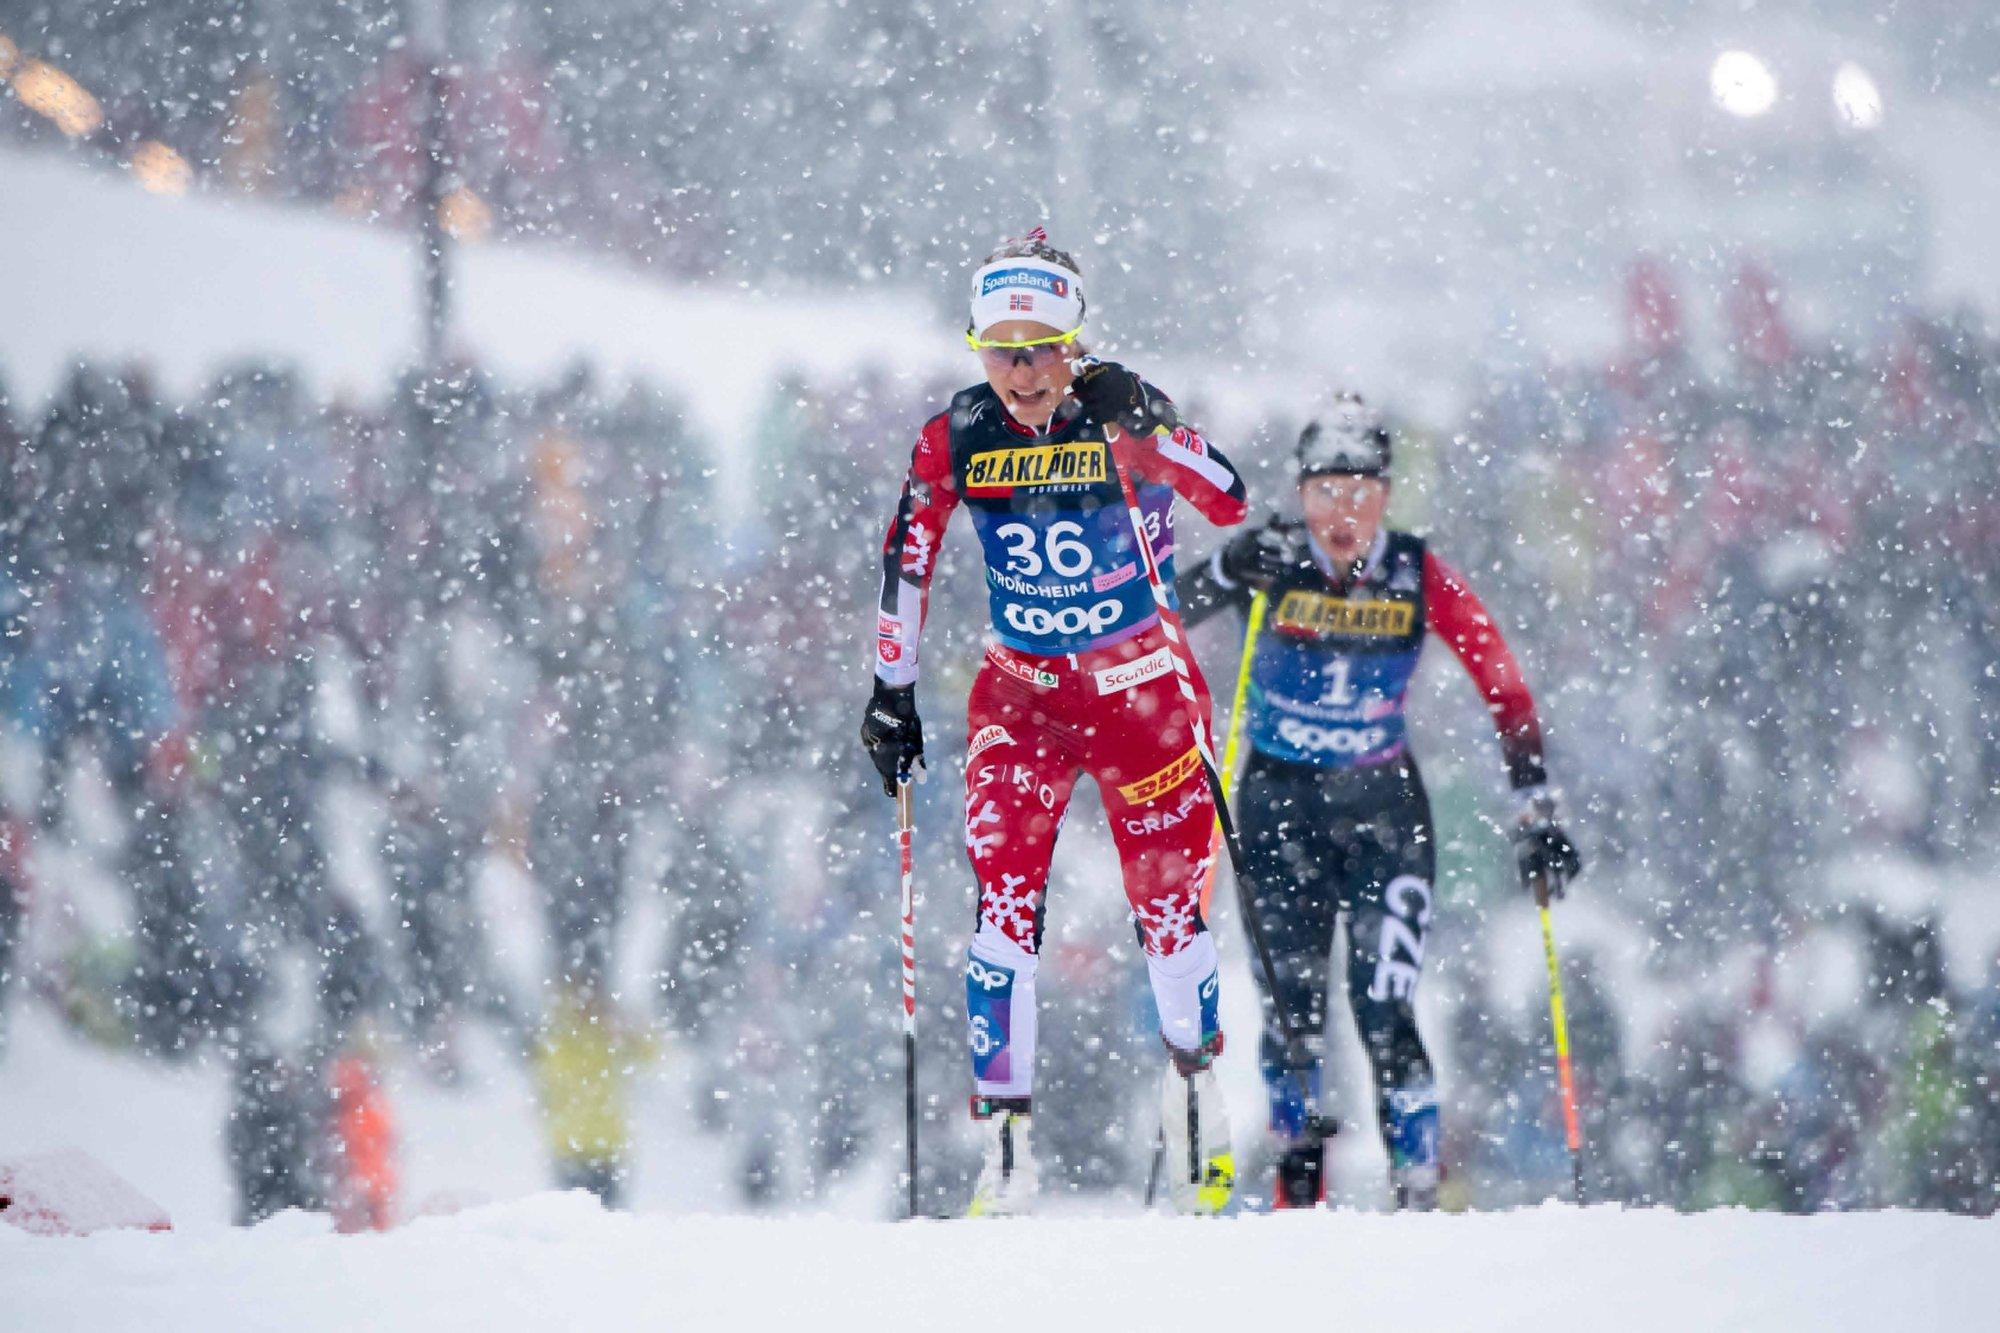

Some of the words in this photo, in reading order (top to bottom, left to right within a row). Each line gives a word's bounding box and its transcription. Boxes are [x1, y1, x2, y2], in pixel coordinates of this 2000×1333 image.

[984, 272, 1052, 291] SpareBank
[972, 447, 1101, 483] BLÅKLÄDER
[996, 520, 1093, 578] 36
[990, 566, 1089, 598] TRONDHEIM
[1105, 657, 1165, 687] Scandic
[1320, 658, 1354, 705] 1
[1132, 755, 1199, 799] DHL
[1126, 787, 1203, 835] CRAFT
[1371, 874, 1431, 1002] CZE
